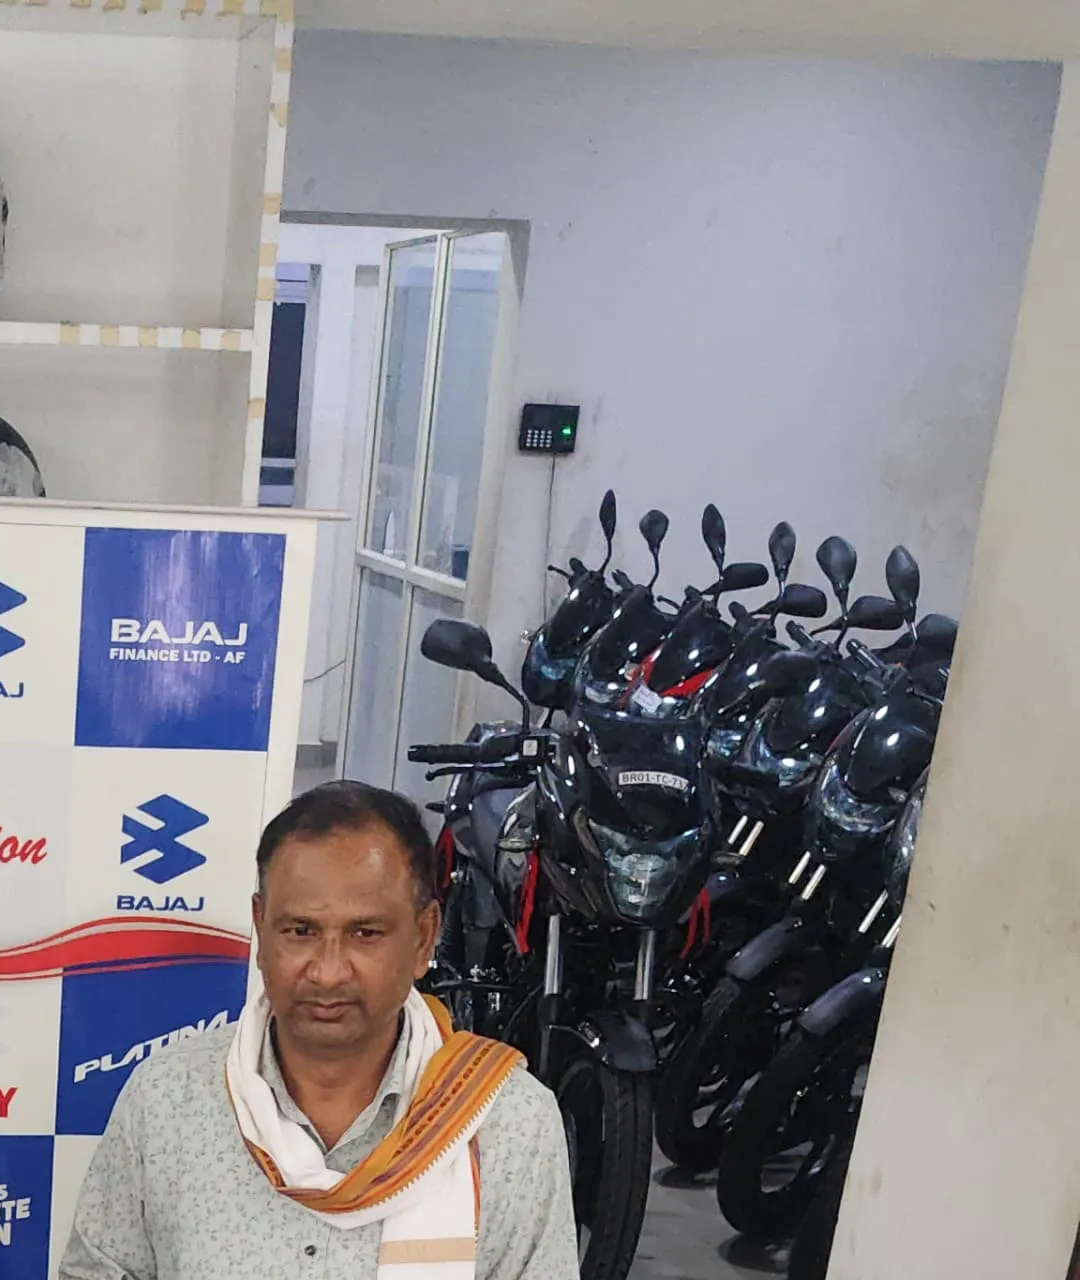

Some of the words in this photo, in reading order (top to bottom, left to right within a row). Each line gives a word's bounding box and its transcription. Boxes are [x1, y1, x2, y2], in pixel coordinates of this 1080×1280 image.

[111, 618, 248, 646] BAJAJ
[109, 647, 179, 662] FINANCE
[183, 650, 211, 663] LTD
[223, 651, 246, 664] AF
[116, 895, 205, 913] BAJAJ
[74, 1010, 240, 1083] PLATINA
